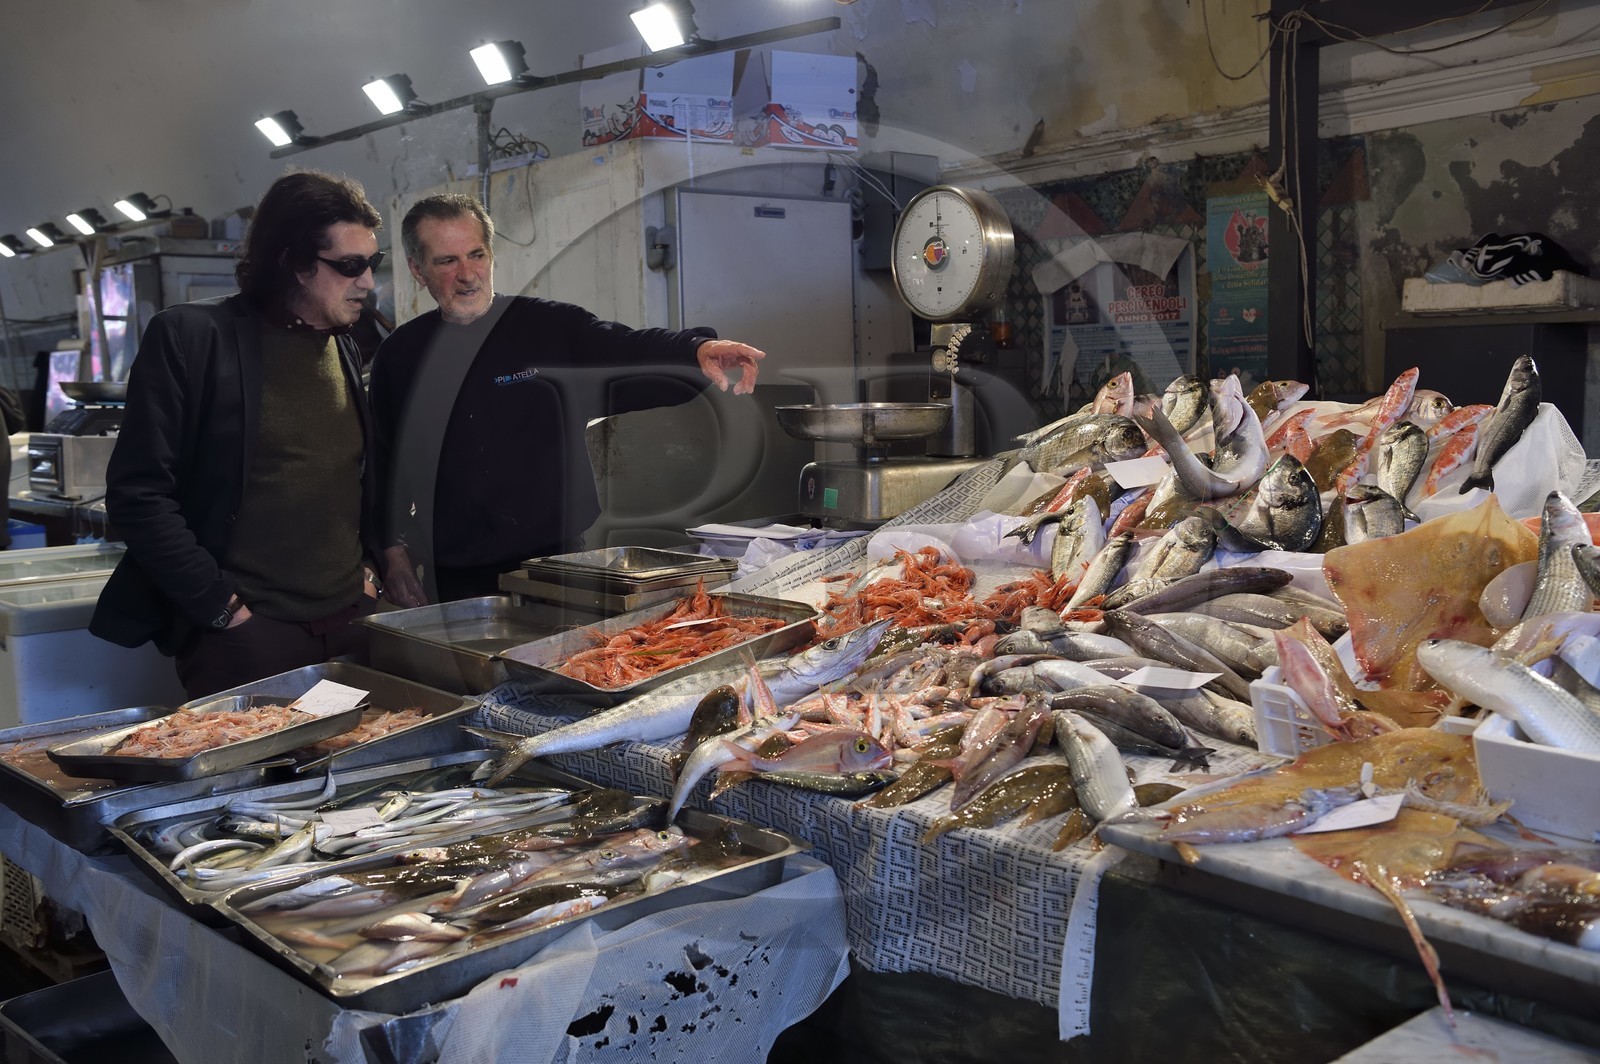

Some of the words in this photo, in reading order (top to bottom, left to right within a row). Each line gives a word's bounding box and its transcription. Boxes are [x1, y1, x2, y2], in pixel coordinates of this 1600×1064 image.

[1127, 284, 1165, 298] CEREO
[1108, 296, 1187, 313] PESCIVENDOLI
[1117, 315, 1148, 323] ANNO
[1150, 312, 1179, 321] 2017
